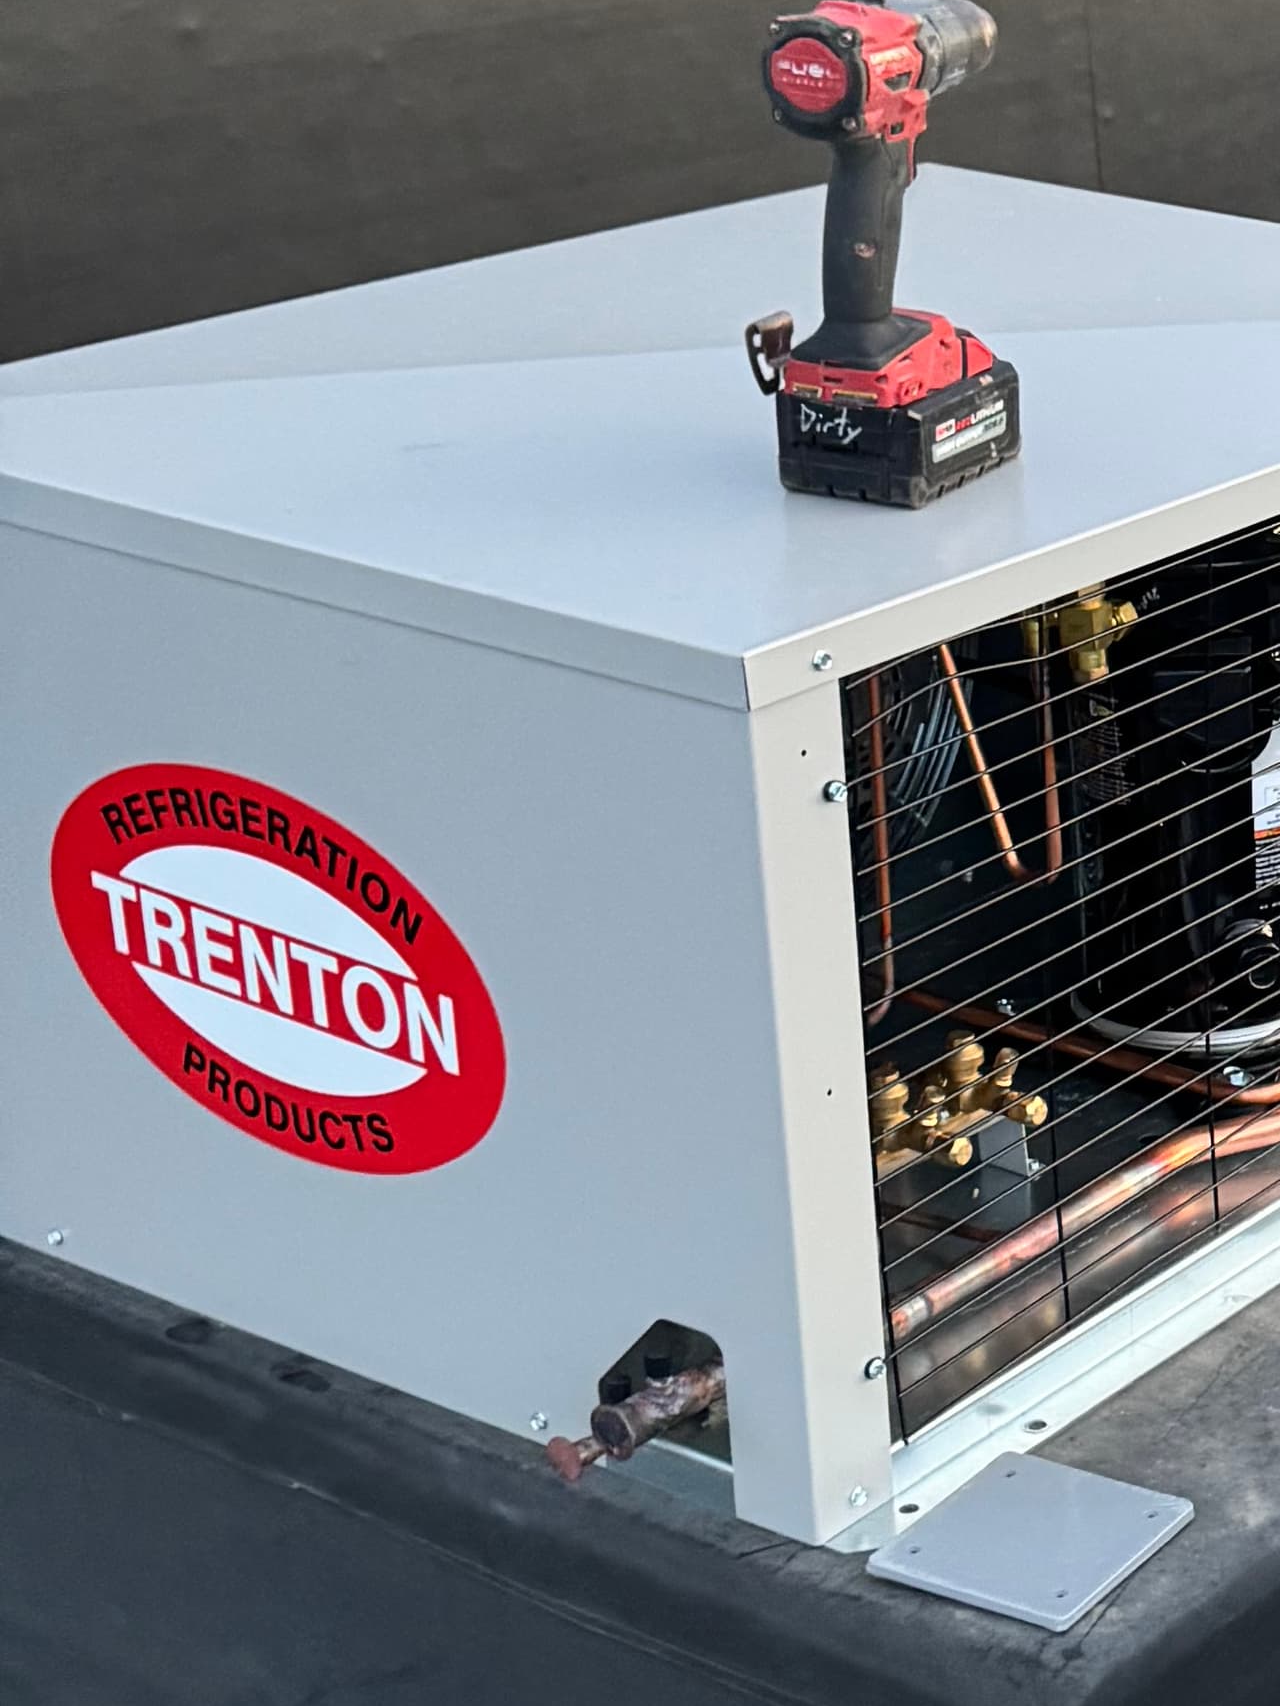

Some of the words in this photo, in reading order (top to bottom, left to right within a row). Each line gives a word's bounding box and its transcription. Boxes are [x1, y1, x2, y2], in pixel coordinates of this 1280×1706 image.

[800, 403, 863, 445] Dirty
[101, 787, 424, 946] REFRIGERATION
[90, 869, 462, 1077] TRENTON
[182, 1041, 396, 1154] PRODUCTS
